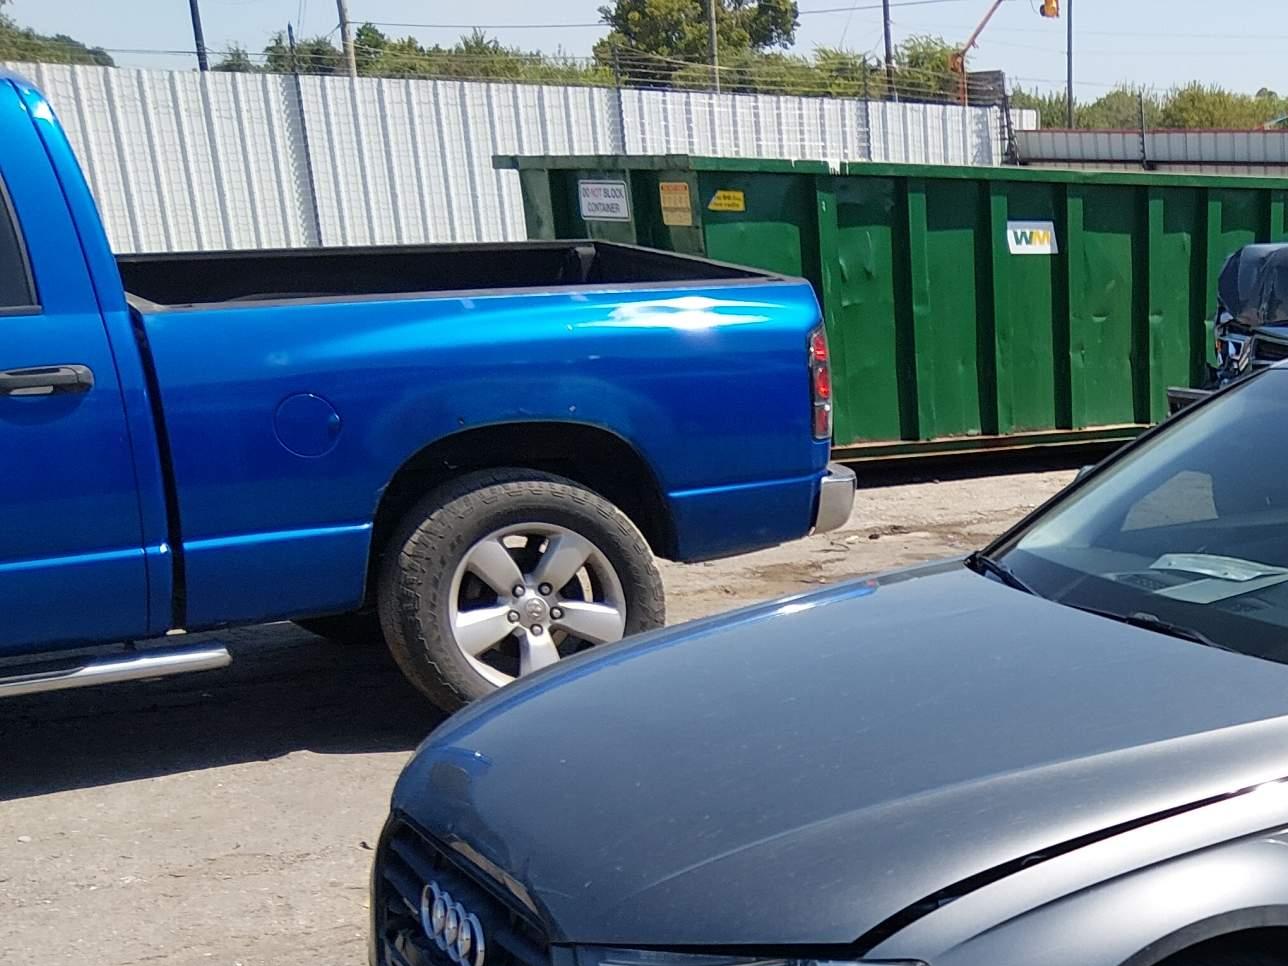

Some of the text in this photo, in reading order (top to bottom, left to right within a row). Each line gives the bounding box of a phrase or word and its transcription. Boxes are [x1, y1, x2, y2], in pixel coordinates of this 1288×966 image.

[603, 187, 625, 200] BLOCK
[587, 202, 620, 214] CONTAINER
[1013, 231, 1051, 246] WM
